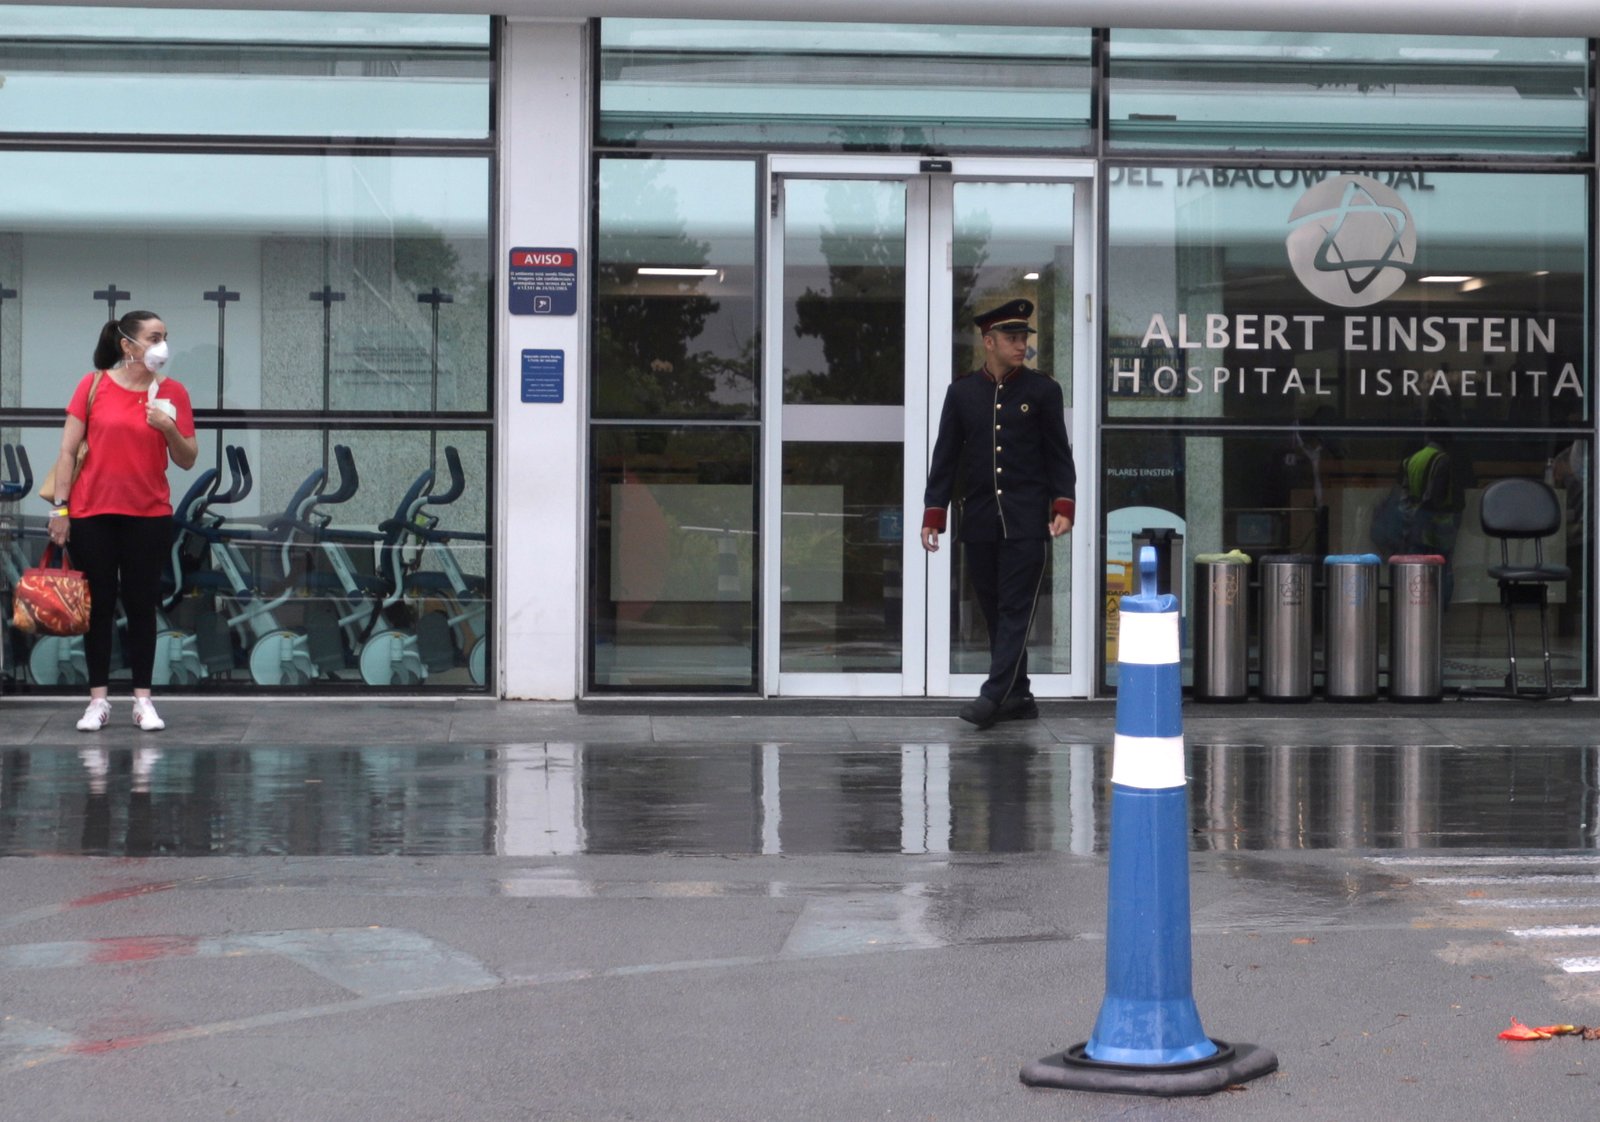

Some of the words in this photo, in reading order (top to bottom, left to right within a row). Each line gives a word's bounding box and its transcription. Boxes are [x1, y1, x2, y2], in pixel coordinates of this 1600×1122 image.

[524, 254, 562, 265] AVISO
[1141, 313, 1325, 351] ALBERT
[1344, 315, 1556, 353] EINSTEIN
[1111, 358, 1331, 396] HOSPITAL
[1360, 362, 1583, 398] ISRAELITA
[1107, 467, 1138, 476] PILARES
[1139, 468, 1175, 477] EINSTEIN
